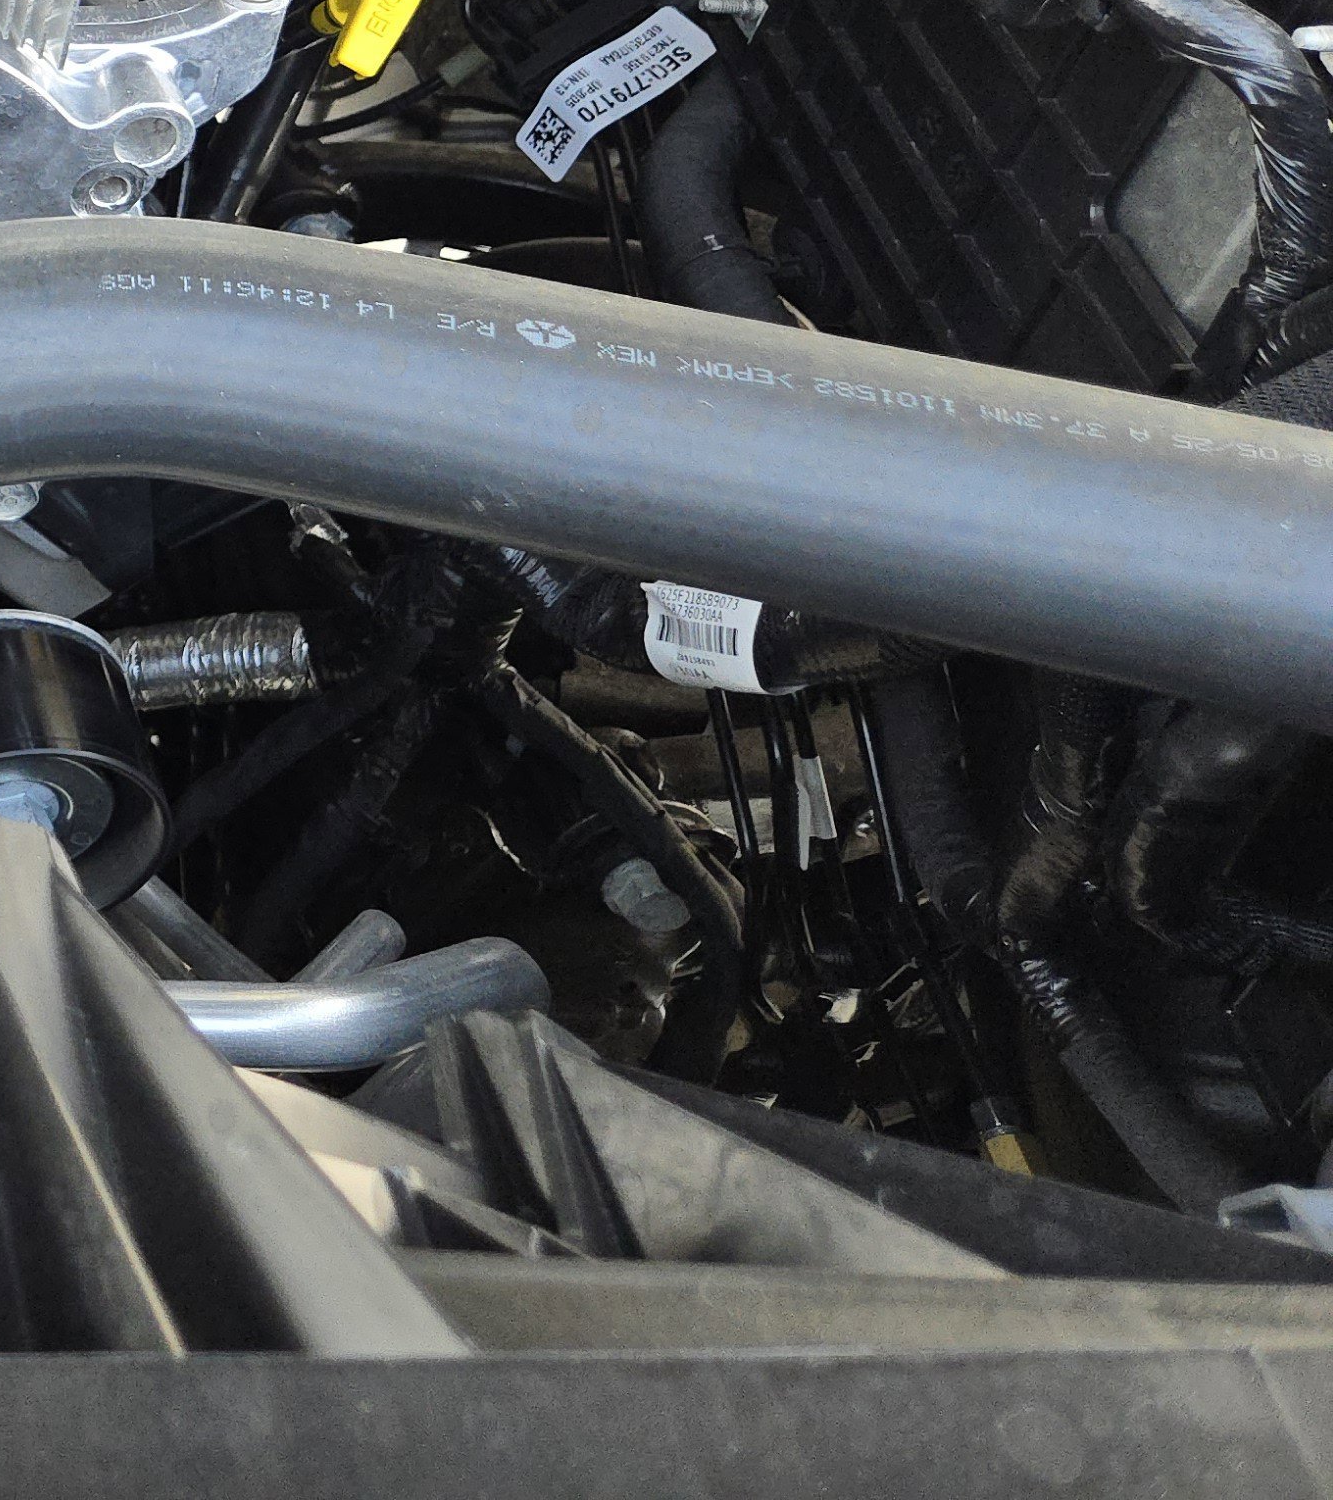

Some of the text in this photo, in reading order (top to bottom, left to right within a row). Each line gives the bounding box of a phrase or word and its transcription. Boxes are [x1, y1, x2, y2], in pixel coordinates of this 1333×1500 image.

[178, 275, 332, 311] 12:46:11
[355, 299, 396, 320] L4
[435, 311, 496, 340] R/E
[596, 341, 658, 368] MEX
[811, 376, 956, 416] 1101582
[978, 403, 1107, 440] 37.3MM
[1128, 424, 1151, 443] A
